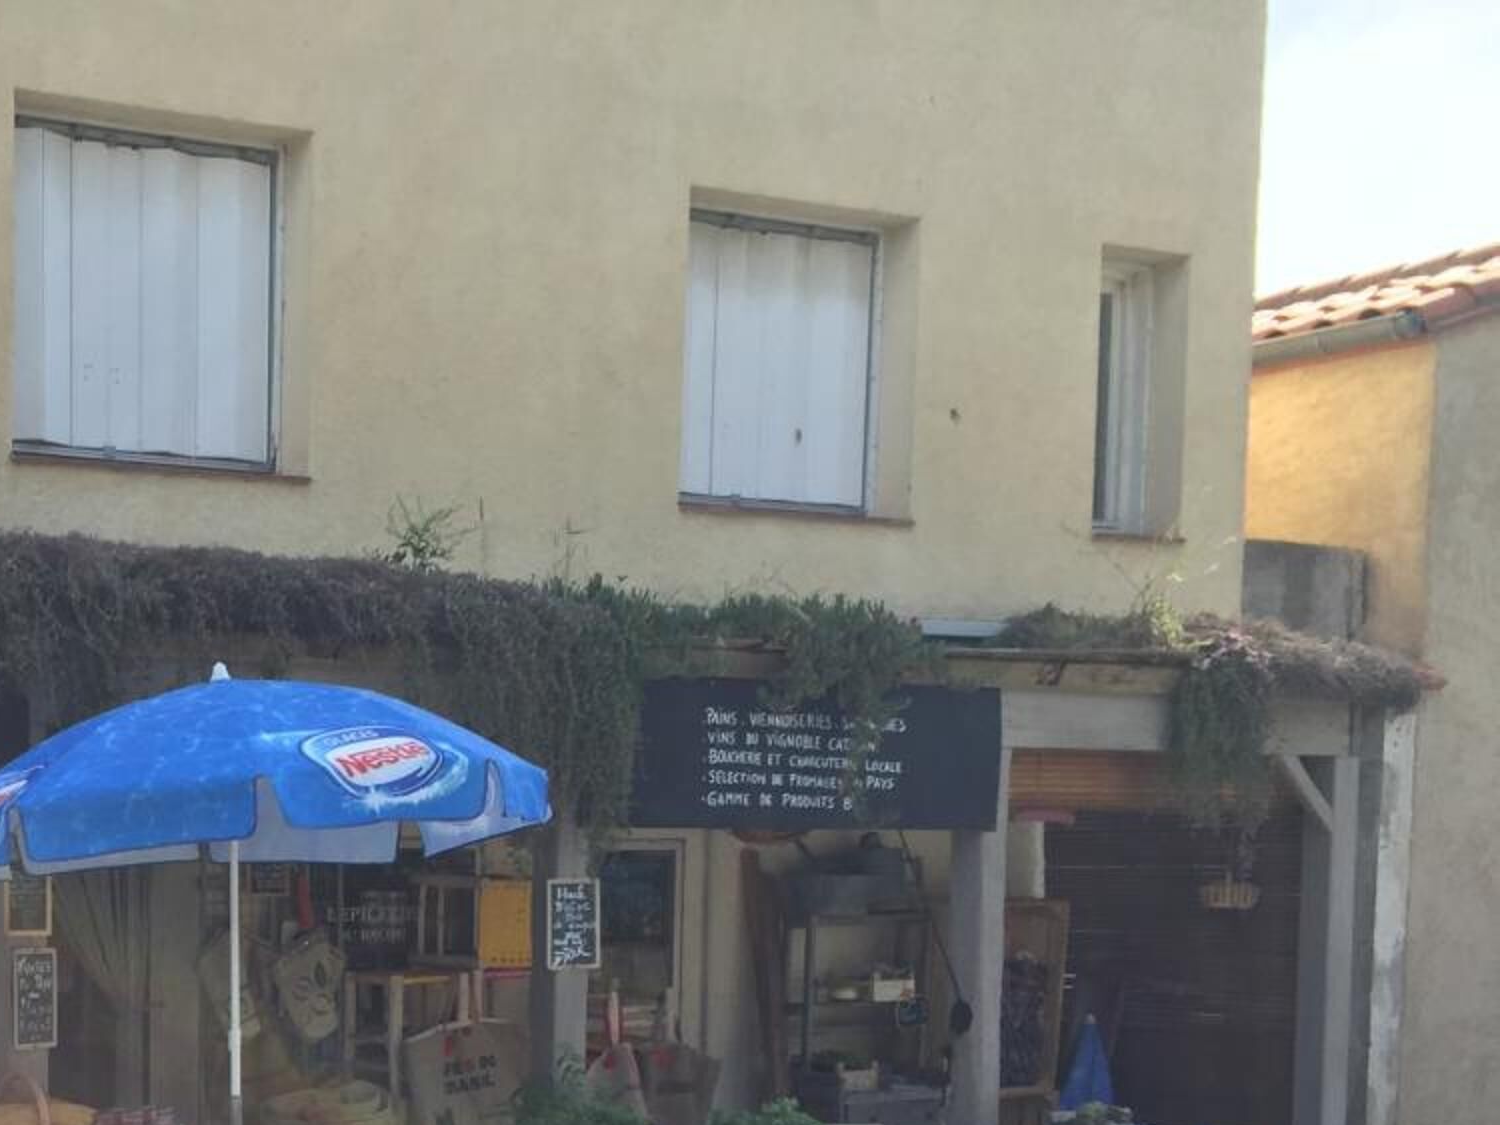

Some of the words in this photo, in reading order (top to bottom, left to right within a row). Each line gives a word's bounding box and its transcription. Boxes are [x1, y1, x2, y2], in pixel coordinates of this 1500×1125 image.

[768, 753, 781, 766] ET
[789, 755, 857, 770] CHARCUTER
[865, 760, 901, 773] LOCALE
[866, 775, 895, 790] PAYS
[707, 791, 749, 808] GAMME
[783, 792, 835, 810] PRODUITS
